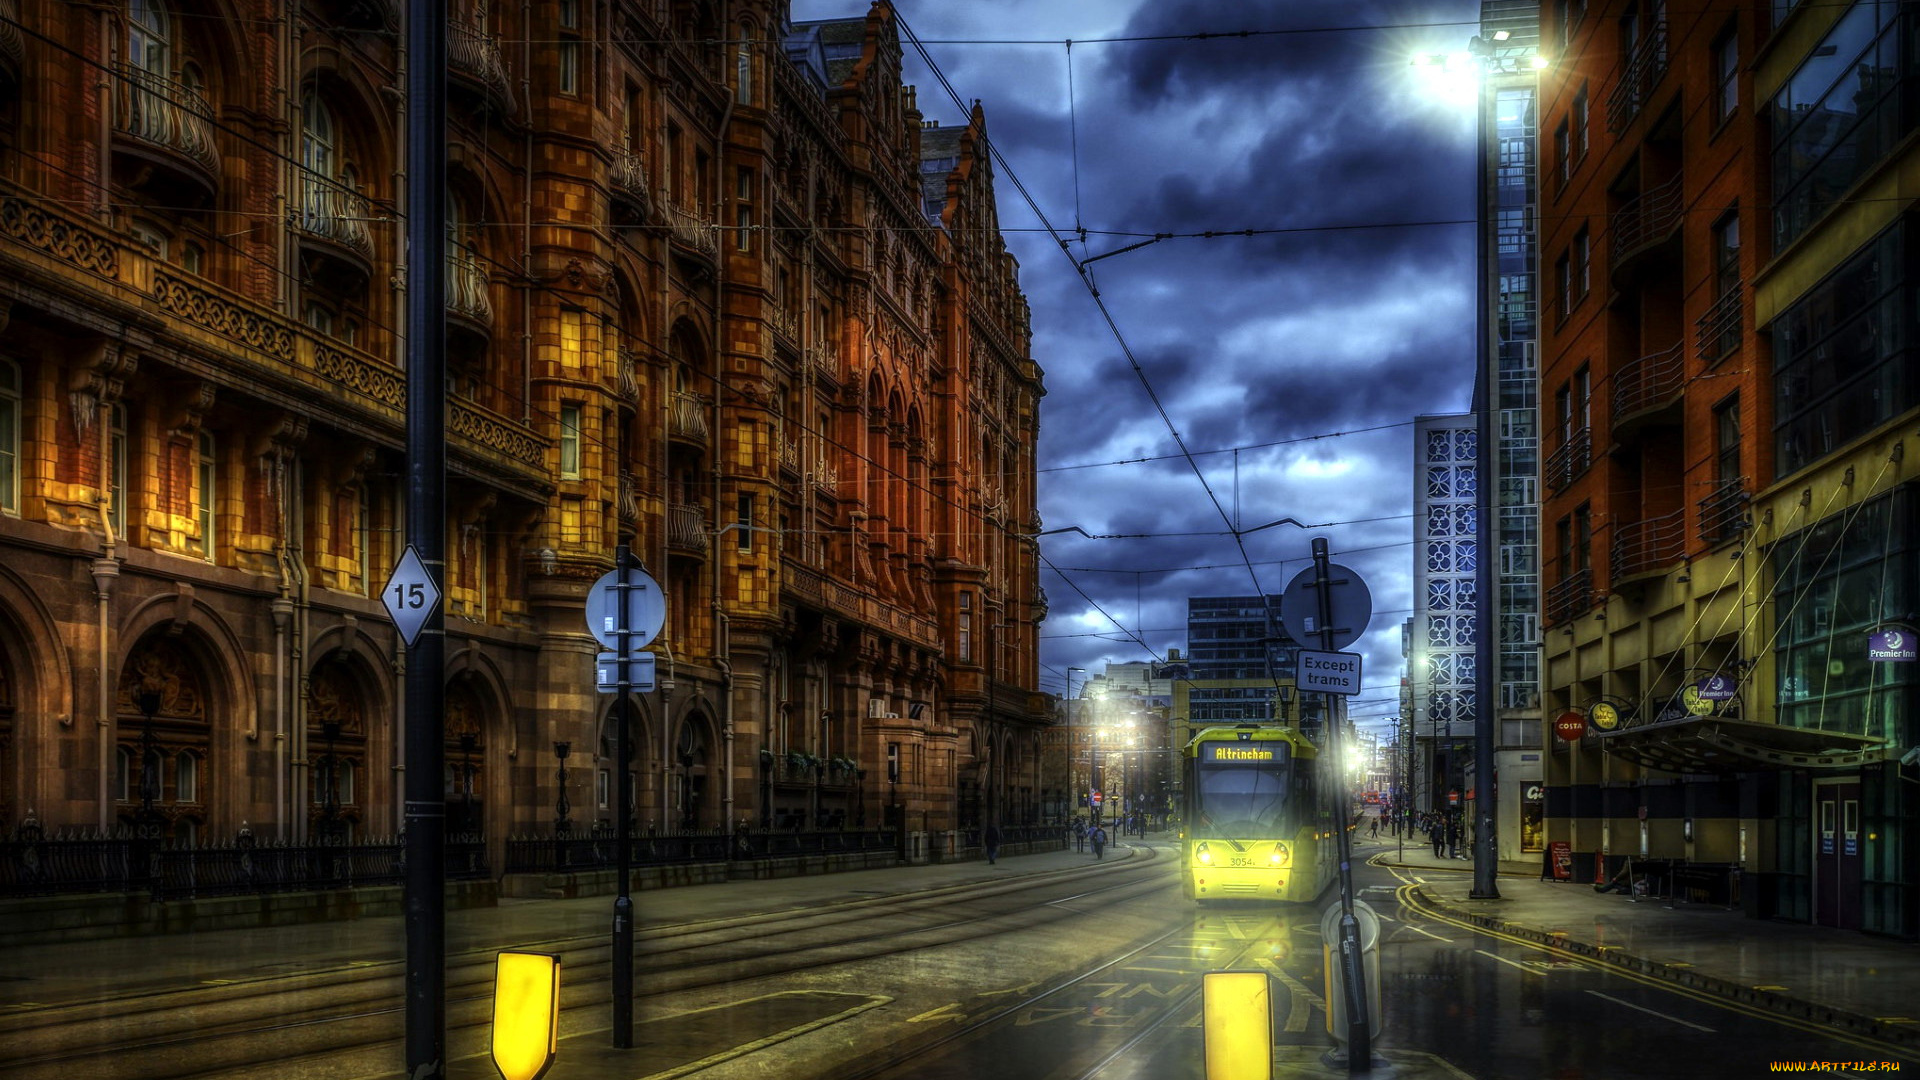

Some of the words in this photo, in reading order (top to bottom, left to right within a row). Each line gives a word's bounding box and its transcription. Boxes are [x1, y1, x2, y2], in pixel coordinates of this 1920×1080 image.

[394, 583, 425, 609] 15
[1870, 649, 1902, 658] Premier
[1903, 649, 1916, 658] Inn
[1304, 656, 1354, 673] Except
[1308, 672, 1349, 687] trams
[1216, 748, 1273, 760] Altrincham
